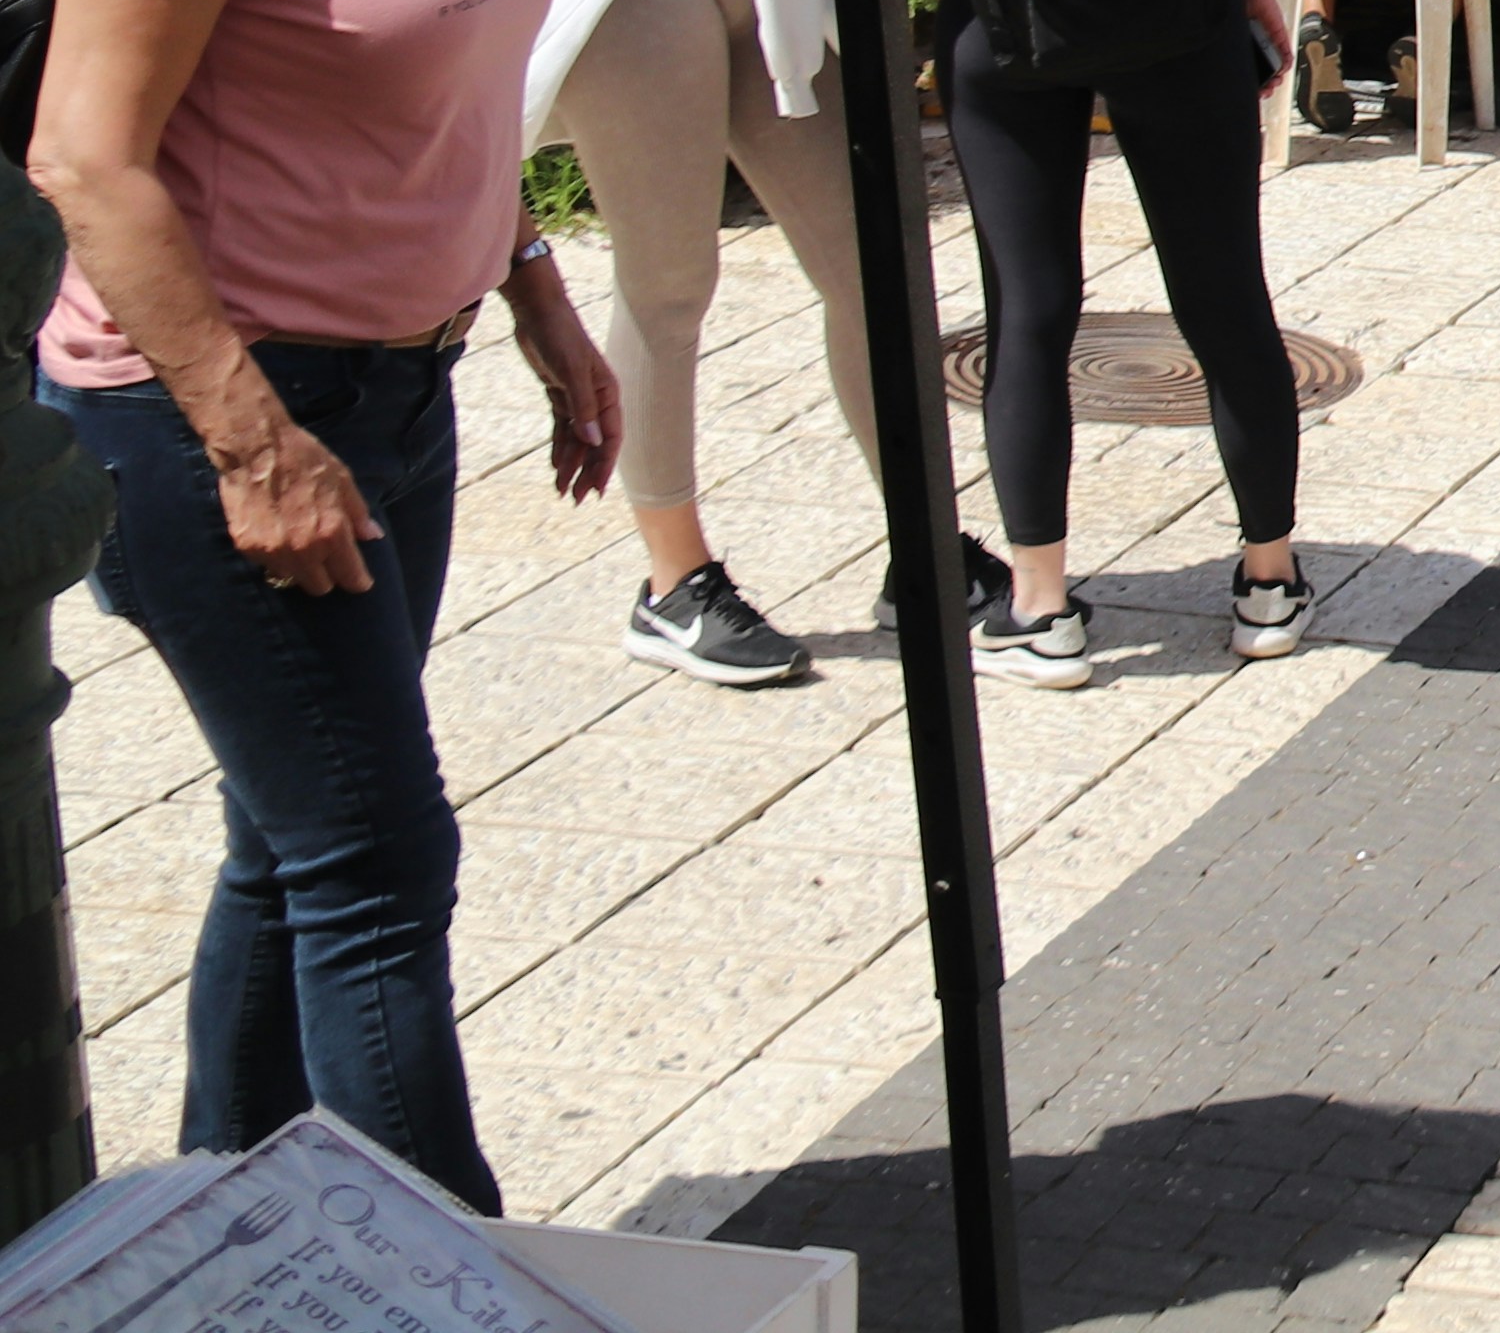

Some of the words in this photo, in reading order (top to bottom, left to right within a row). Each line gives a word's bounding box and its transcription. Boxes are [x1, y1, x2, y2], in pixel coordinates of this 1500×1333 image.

[317, 1182, 399, 1257] Our
[215, 1289, 265, 1317] If
[251, 1261, 300, 1290] If
[282, 1289, 350, 1332] you
[287, 1235, 336, 1264] If
[317, 1263, 384, 1306] you
